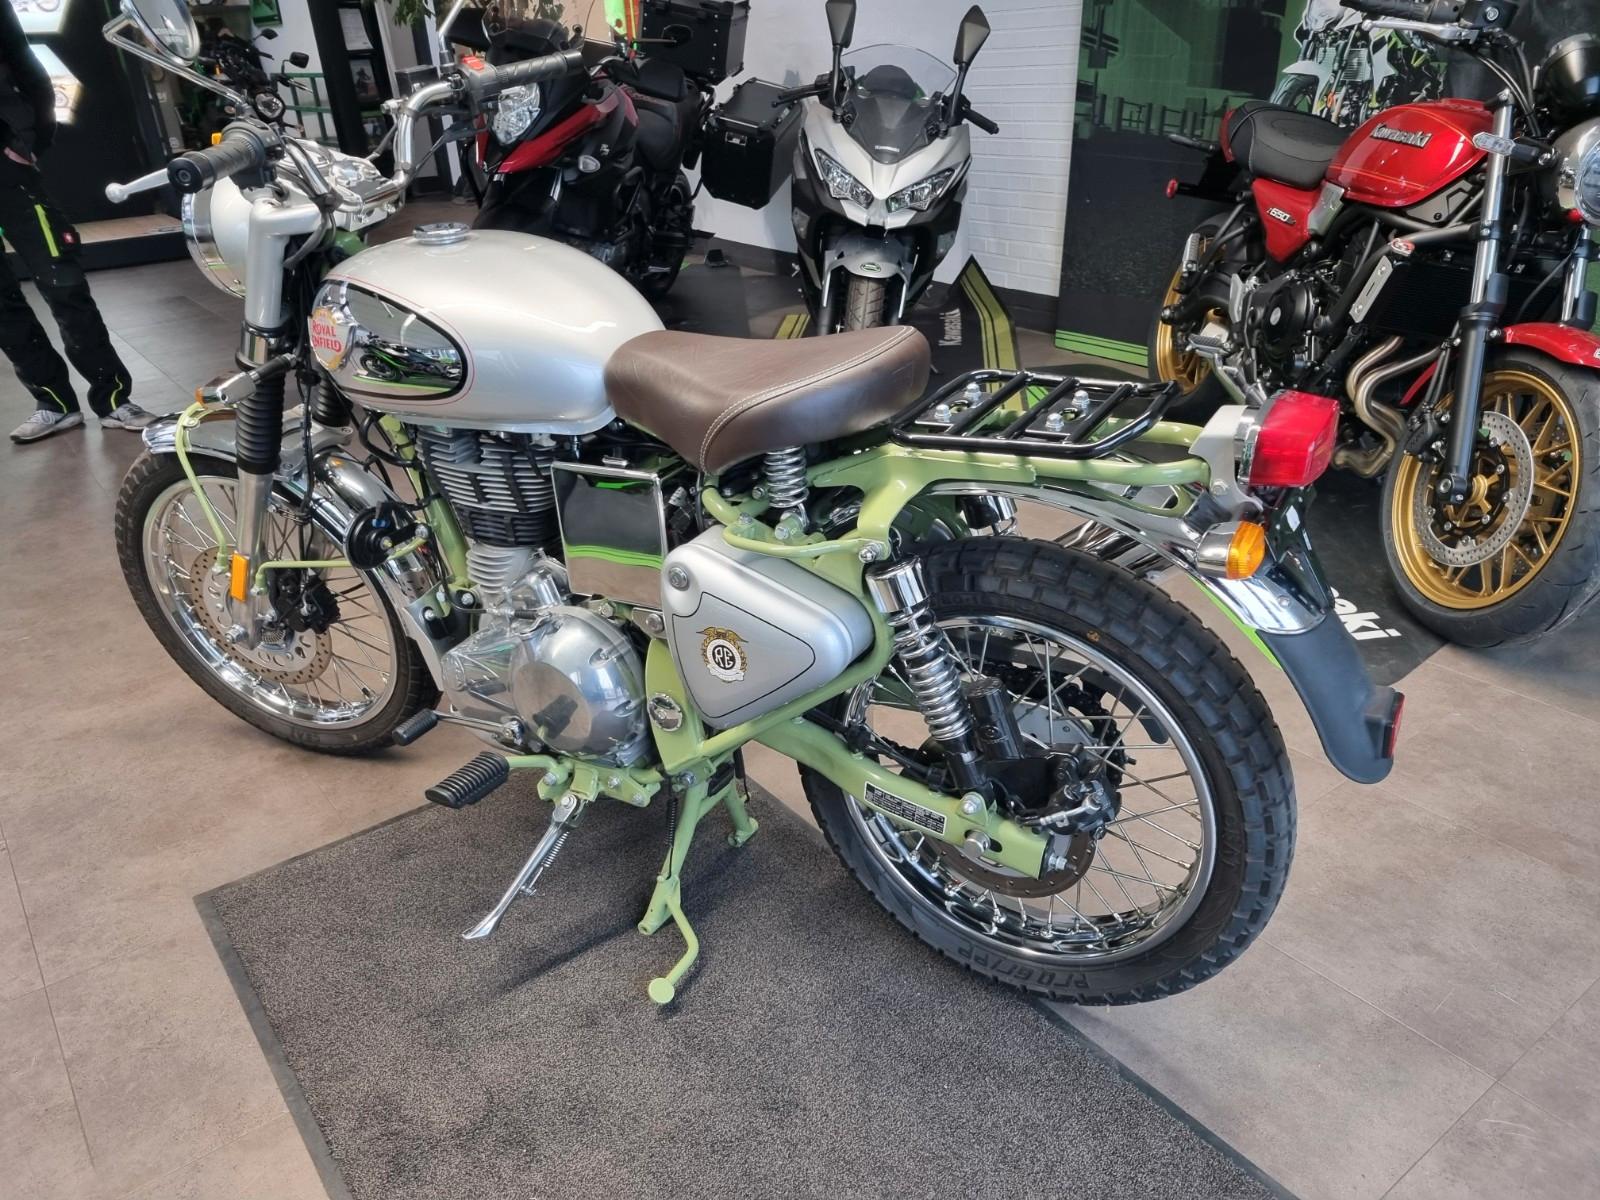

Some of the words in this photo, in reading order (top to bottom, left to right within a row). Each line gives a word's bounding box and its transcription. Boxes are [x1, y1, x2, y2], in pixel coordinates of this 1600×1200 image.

[1370, 123, 1432, 149] Kawasaki
[312, 320, 337, 337] ROYAL
[938, 308, 962, 346] Kawasaki
[312, 335, 342, 353] ENFIELD
[714, 646, 735, 669] RE
